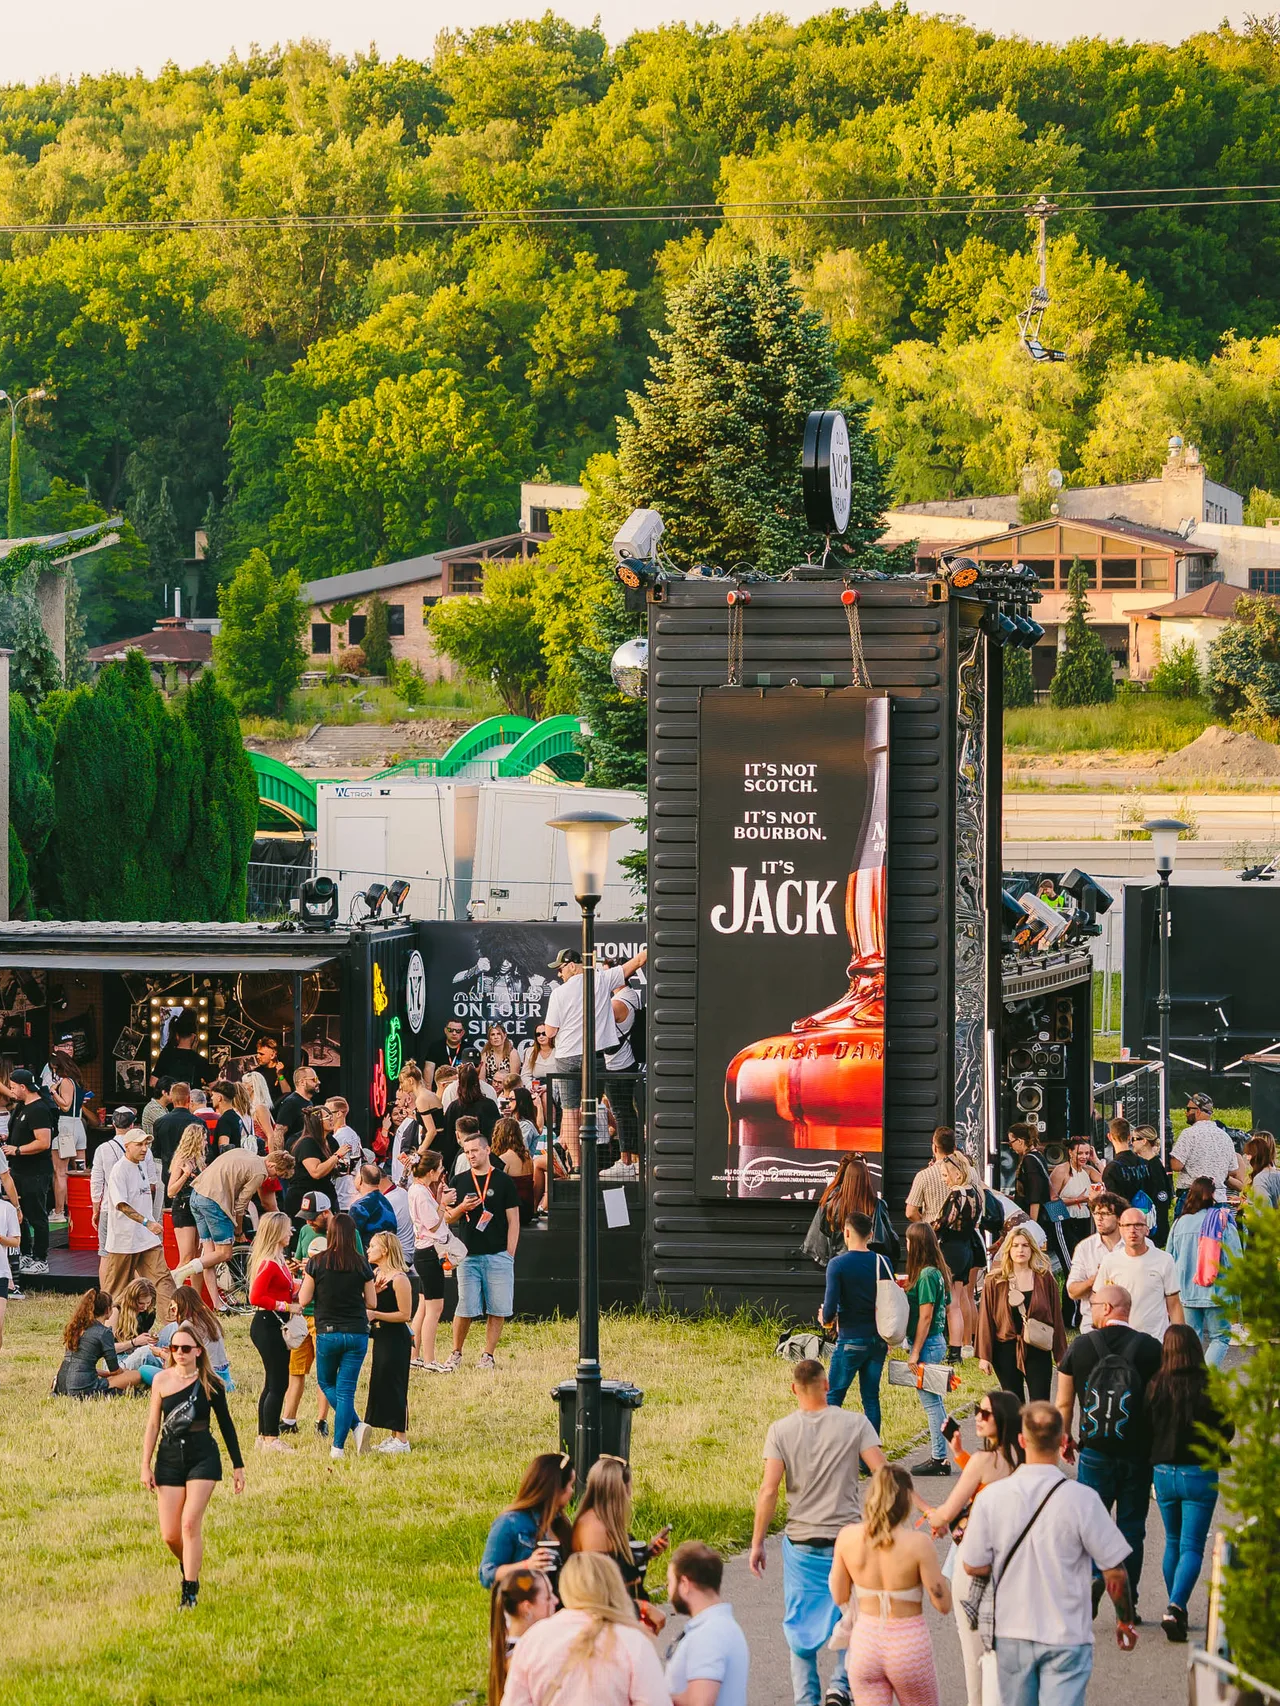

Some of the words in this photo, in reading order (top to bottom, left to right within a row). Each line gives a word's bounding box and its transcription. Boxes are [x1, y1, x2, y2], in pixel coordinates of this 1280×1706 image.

[744, 763, 777, 776] IT'S
[781, 764, 817, 777] NOT
[744, 779, 818, 792] SCOTCH.
[744, 810, 777, 824] IT'S
[781, 812, 817, 824] NOT
[734, 827, 827, 840] BOURBON.
[761, 860, 795, 874] IT'S
[710, 866, 838, 935] JACK
[453, 1002, 483, 1018] ON
[486, 1002, 542, 1018] TOUR
[468, 1020, 527, 1035] SICE
